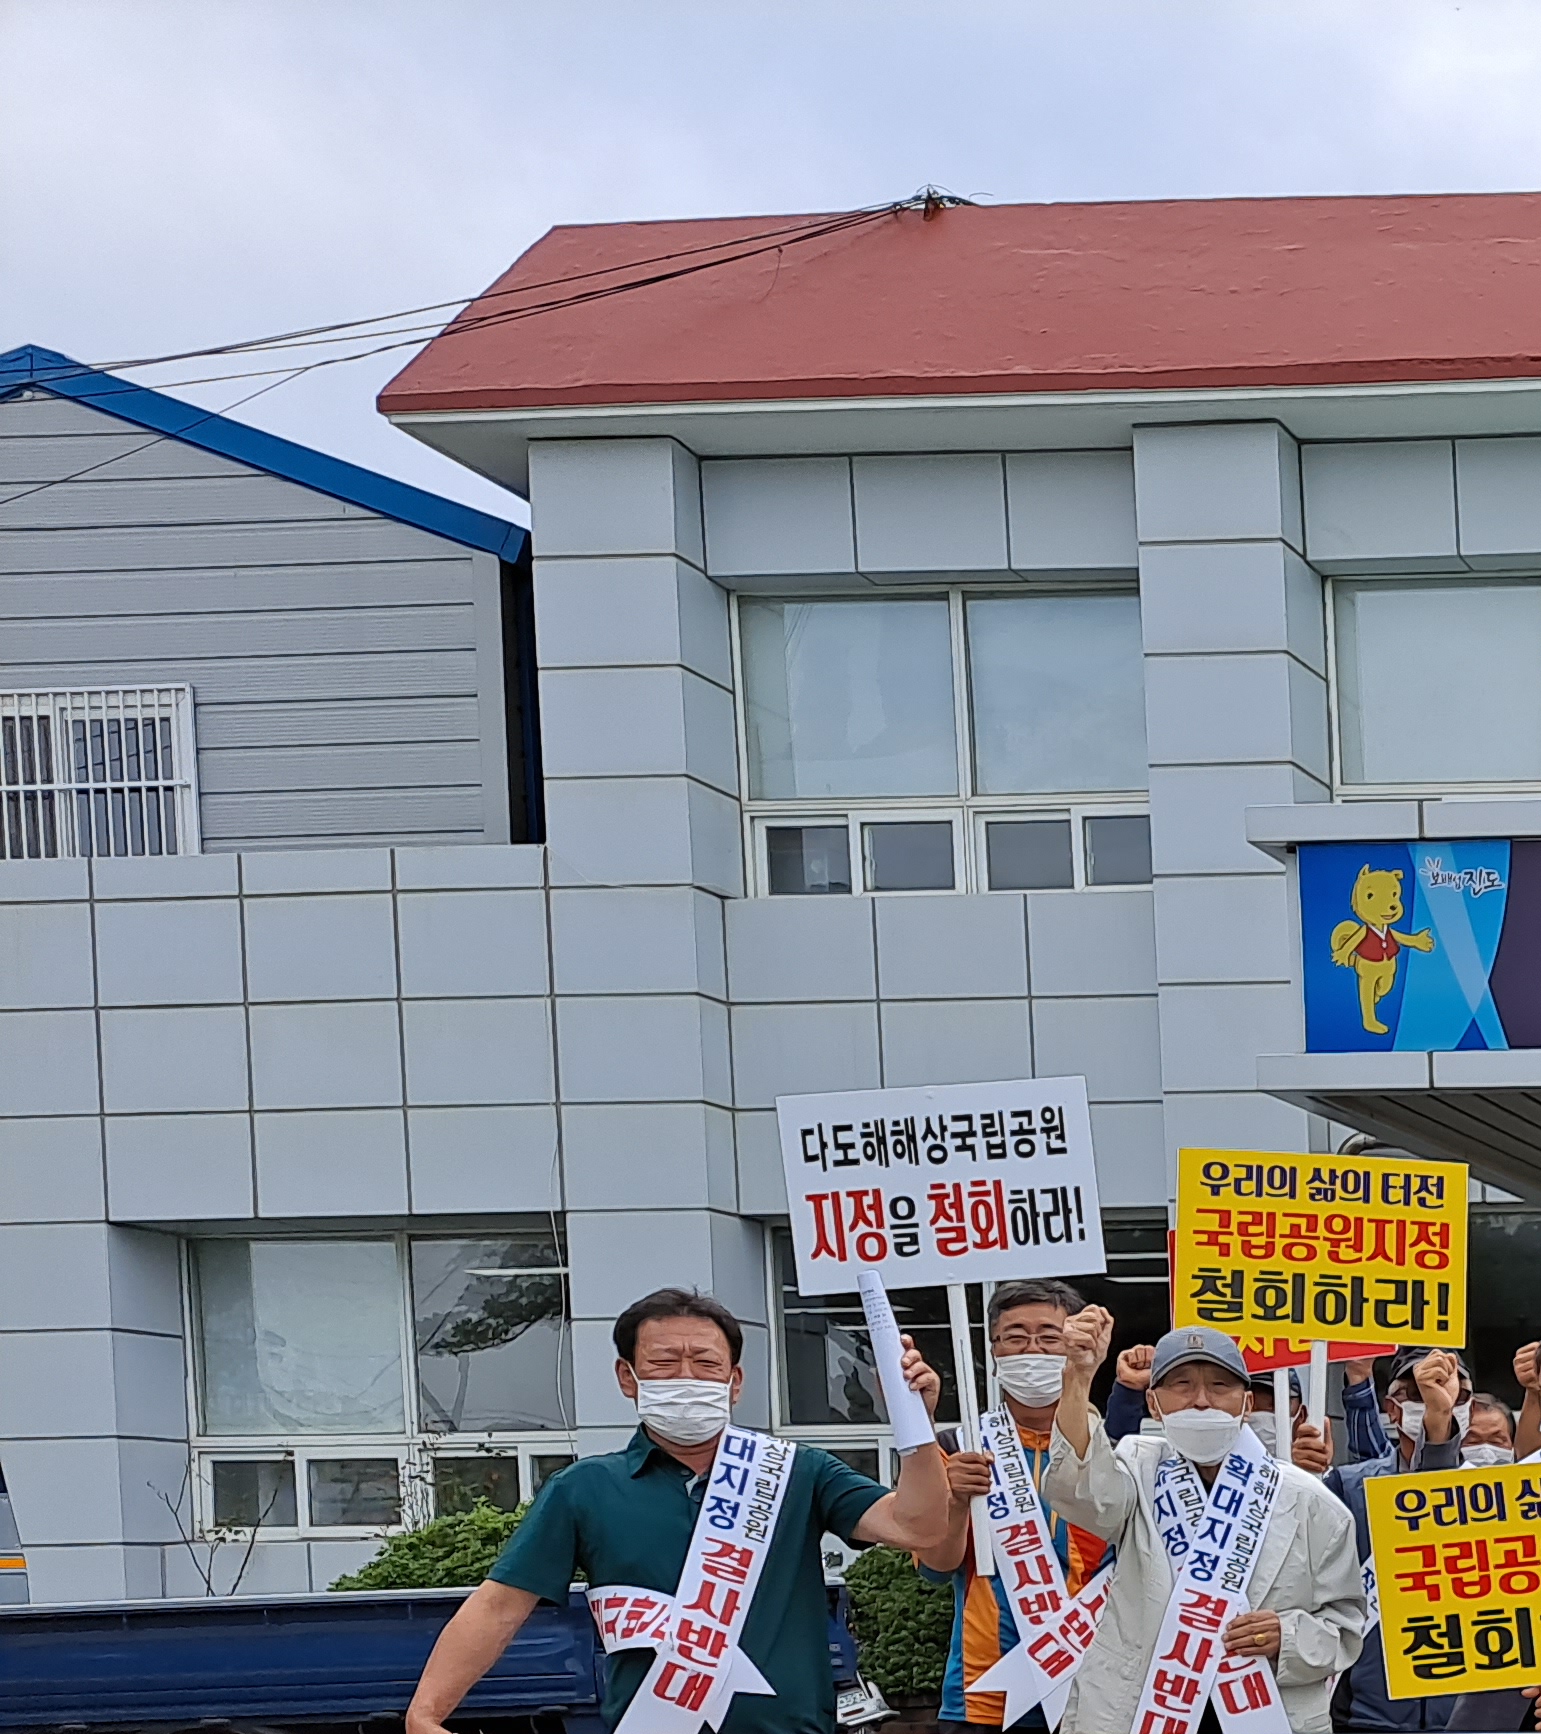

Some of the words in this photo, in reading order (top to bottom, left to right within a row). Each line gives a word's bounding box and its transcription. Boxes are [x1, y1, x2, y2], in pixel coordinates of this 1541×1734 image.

[800, 1105, 1068, 1172] 다도해해상국립공원
[805, 1188, 921, 1263] 지정을
[927, 1178, 1087, 1257] 철회하라!
[1200, 1161, 1297, 1200] 우리의
[1306, 1166, 1371, 1204] 삶의
[1381, 1172, 1445, 1210] 터전
[1192, 1207, 1451, 1271] 국립공원지정
[1189, 1267, 1451, 1332] 철회하라!
[704, 1430, 757, 1530] 대지정
[742, 1437, 793, 1543] 상국립공원
[1187, 1453, 1254, 1582] 확대지정
[1394, 1481, 1507, 1531] 우리의
[652, 1536, 755, 1712] 결사반대
